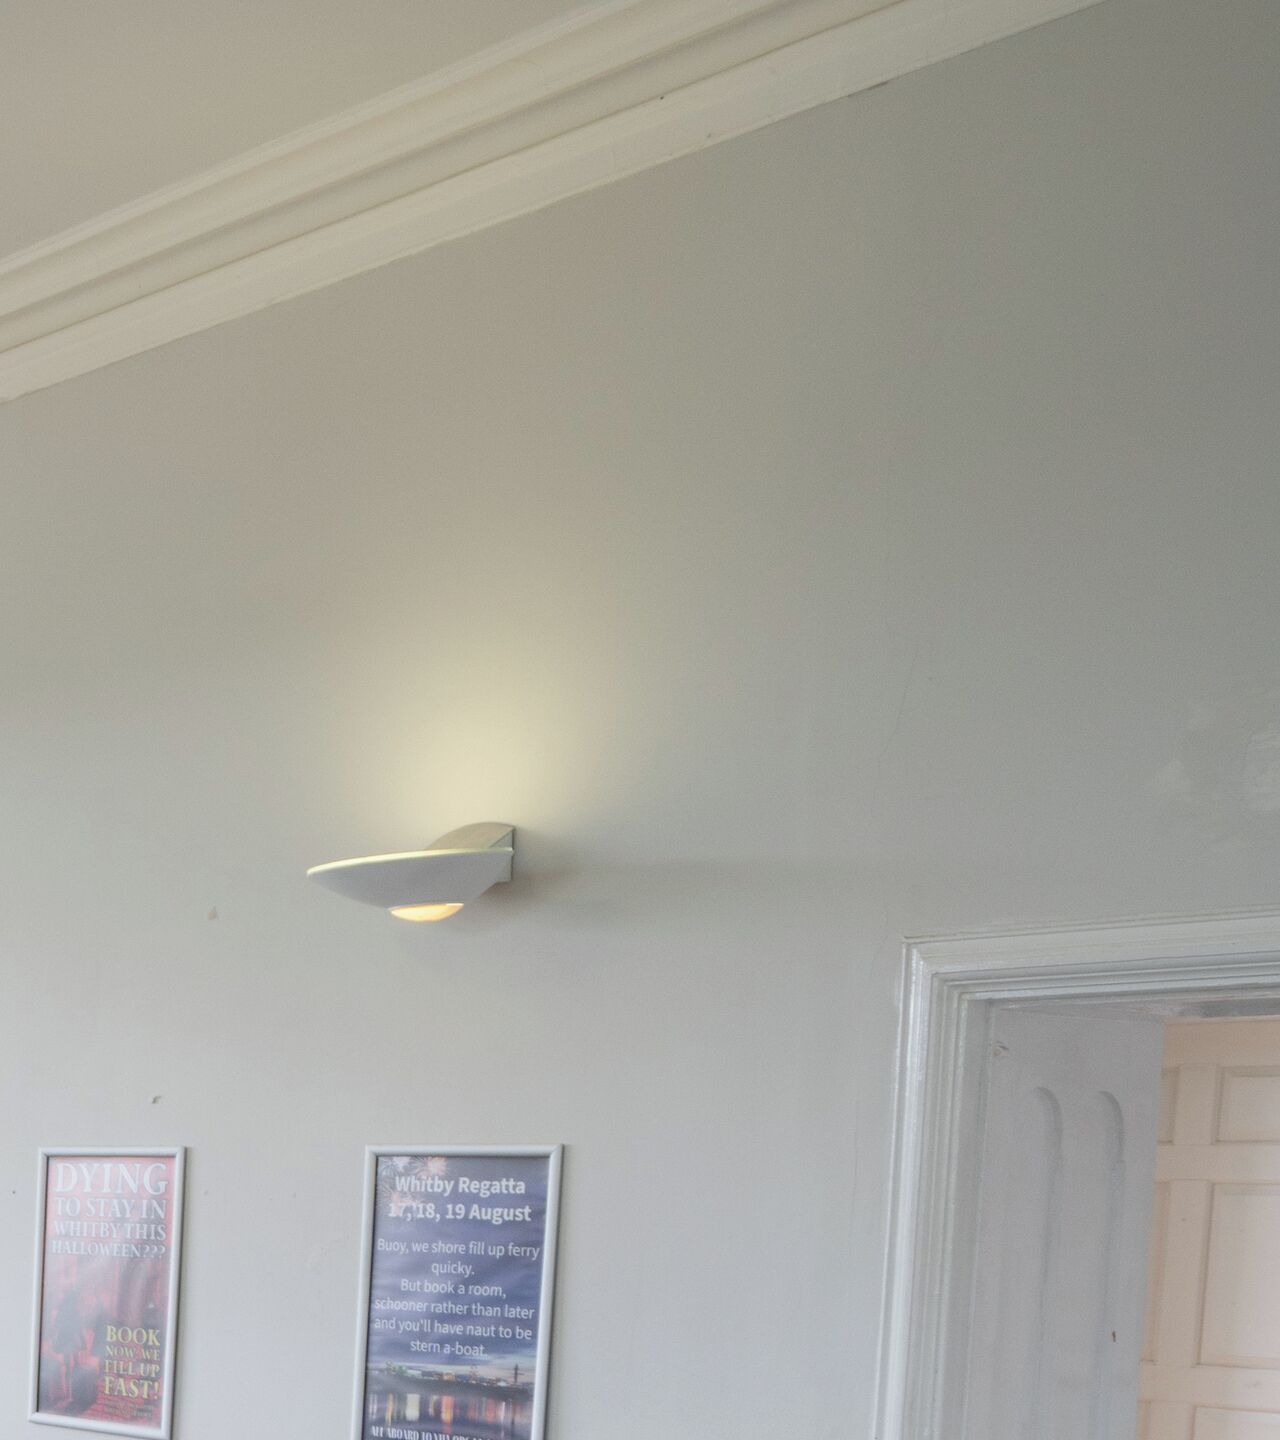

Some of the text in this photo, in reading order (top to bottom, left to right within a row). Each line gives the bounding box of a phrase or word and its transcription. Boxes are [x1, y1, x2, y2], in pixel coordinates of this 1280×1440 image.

[55, 1163, 169, 1195] DYING
[395, 1175, 526, 1198] Whitby Regatta
[54, 1197, 167, 1219] TO STAY IN
[416, 1203, 440, 1222] 18,
[446, 1203, 465, 1219] 19
[469, 1204, 532, 1225] August
[54, 1221, 166, 1241] WHITBY THIS
[51, 1241, 166, 1258] HALLOWEEN???
[377, 1238, 540, 1260] Buoy, we shore fill up ferry
[431, 1260, 475, 1278] quicky.
[401, 1279, 506, 1299] But book a room,
[375, 1298, 535, 1319] schooner rather than later
[106, 1325, 160, 1346] BOOK
[374, 1318, 532, 1340] and you'll have naut to be
[106, 1345, 160, 1360] NOW WE
[410, 1340, 440, 1352] stern
[105, 1360, 160, 1377] FILL UP
[104, 1375, 159, 1399] FAST!
